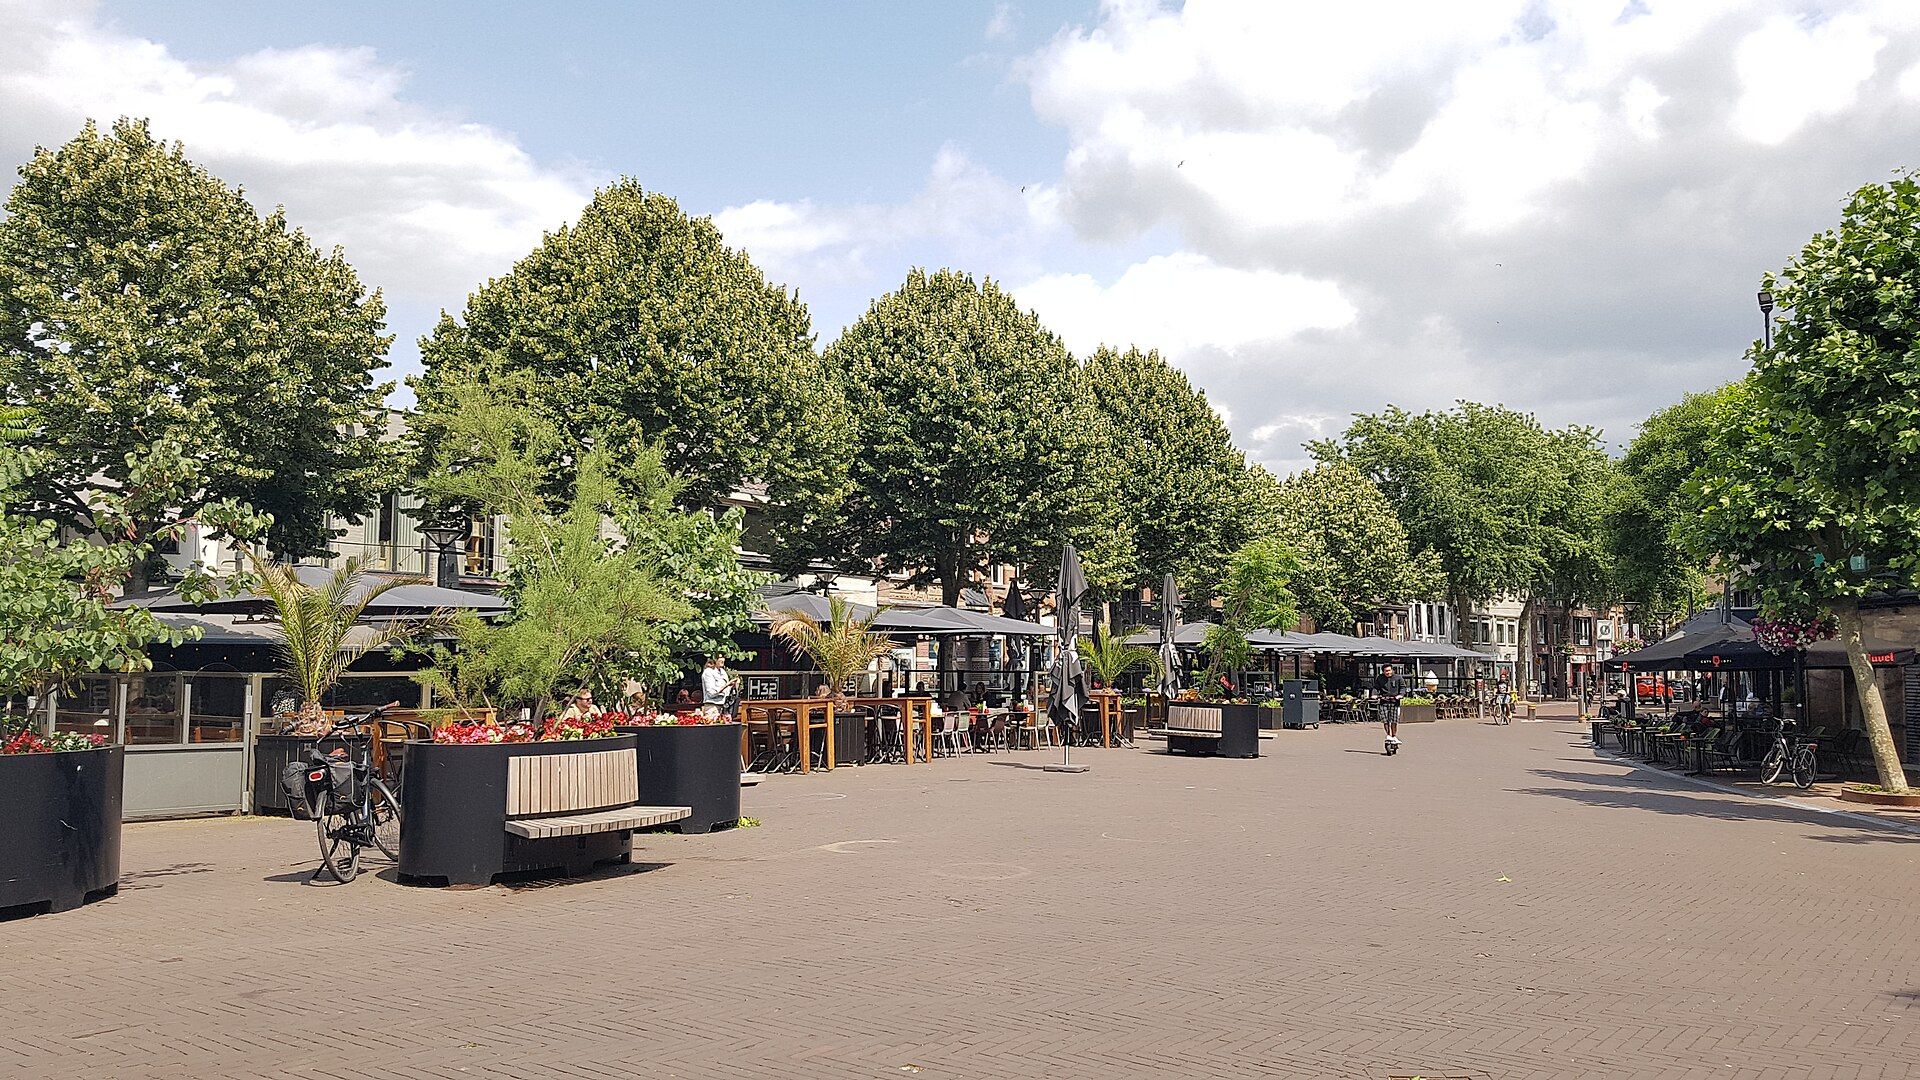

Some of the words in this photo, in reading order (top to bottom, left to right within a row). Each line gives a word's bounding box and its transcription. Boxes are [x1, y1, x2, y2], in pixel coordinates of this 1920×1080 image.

[1868, 652, 1894, 662] uvel
[749, 679, 777, 695] H32
[842, 680, 855, 692] 32
